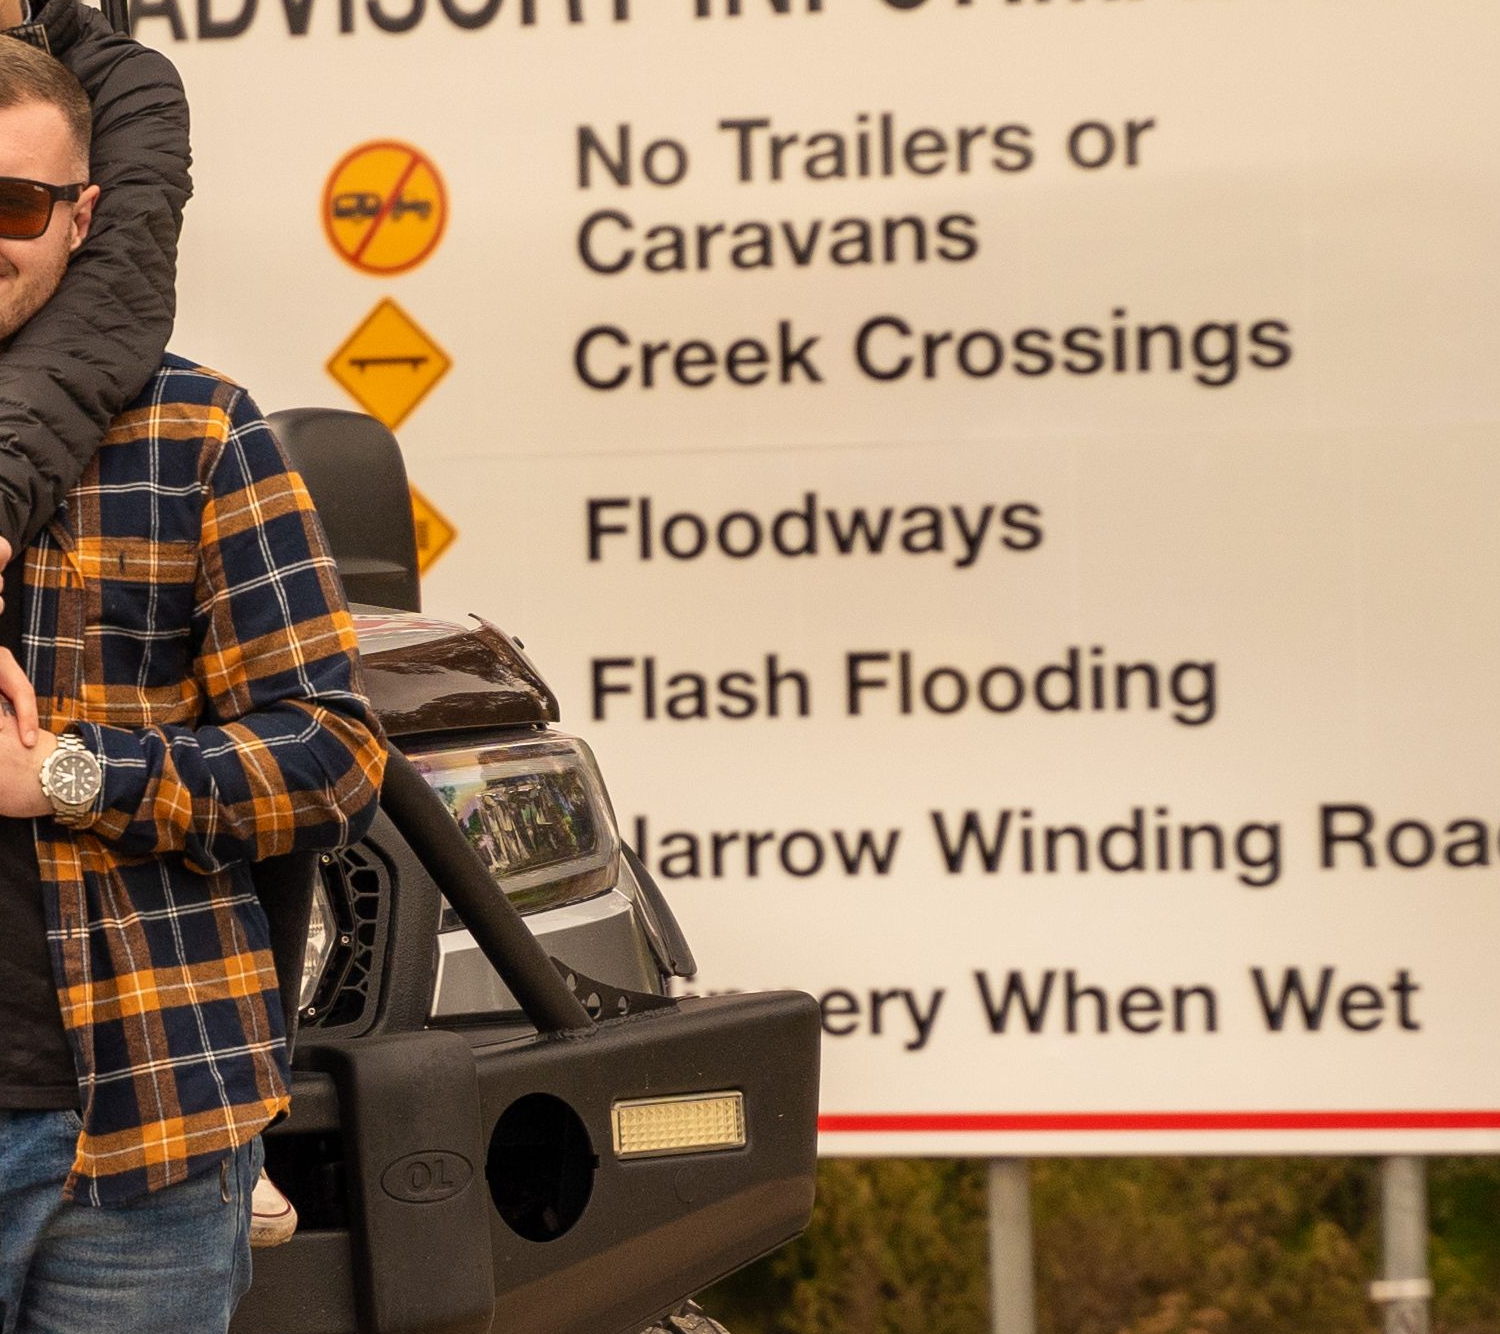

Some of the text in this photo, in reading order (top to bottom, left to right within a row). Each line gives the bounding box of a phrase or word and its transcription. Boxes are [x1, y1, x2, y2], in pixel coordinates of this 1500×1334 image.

[576, 113, 1156, 190] No Trailers or
[576, 202, 980, 276] Caravans
[572, 307, 1293, 393] Creek Crossings
[585, 491, 1045, 570] Floodways
[588, 645, 1218, 728] Flash Flooding
[930, 806, 1283, 889] Winding
[973, 969, 1219, 1035] When
[1249, 966, 1422, 1033] Wet
